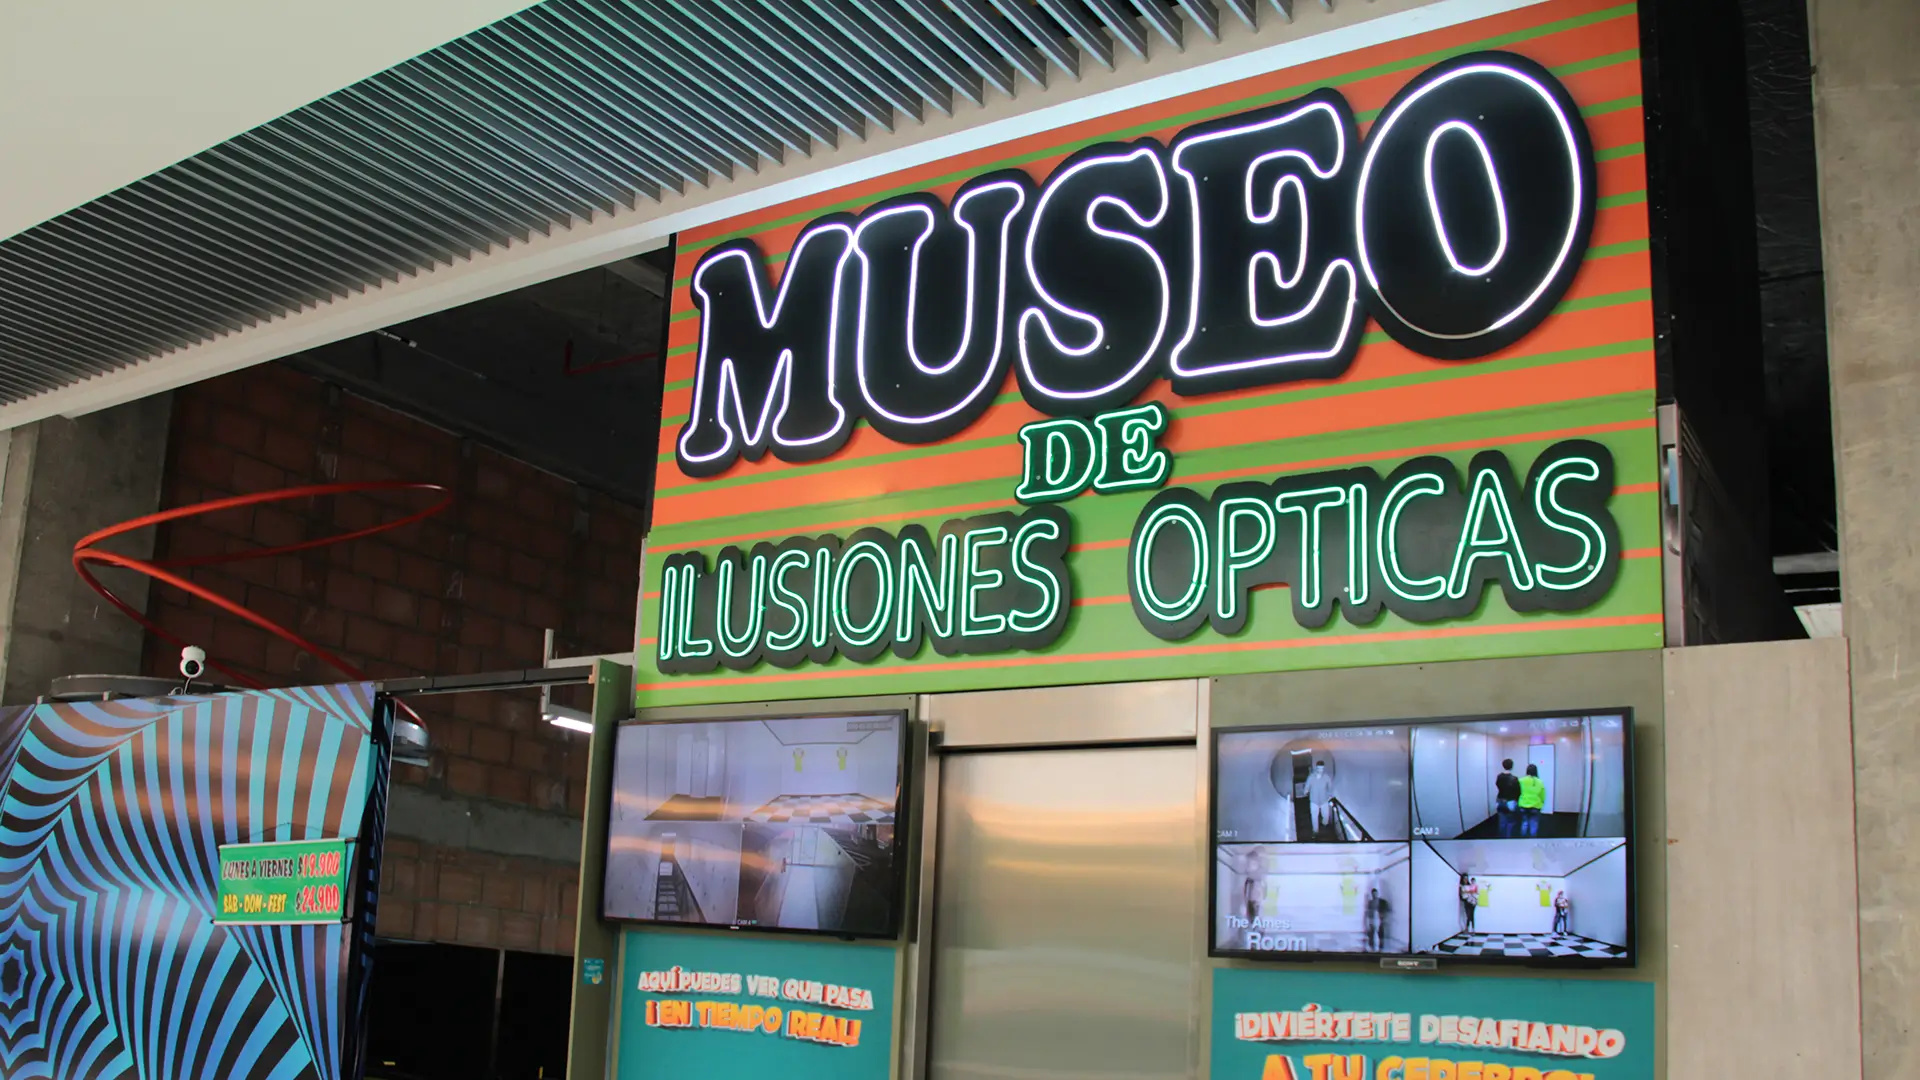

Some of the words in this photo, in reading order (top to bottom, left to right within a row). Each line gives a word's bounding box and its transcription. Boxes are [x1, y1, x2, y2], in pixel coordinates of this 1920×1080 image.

[679, 63, 1583, 462] MUSEO
[1015, 405, 1167, 500] DE
[659, 519, 1061, 660] ILUSIONES
[1135, 457, 1607, 622] OPTICAS
[222, 861, 250, 880] LUNES
[251, 859, 257, 878] A
[259, 858, 294, 879] VIERNES
[1225, 916, 1249, 929] The
[1252, 916, 1291, 929] Ames
[1247, 931, 1308, 951] Room
[638, 966, 683, 992] AQUÍ
[683, 972, 742, 994] PUEDES
[746, 974, 779, 998] VER
[782, 978, 822, 1004] QUE
[823, 984, 874, 1010] PASA
[695, 1001, 783, 1034] TIEMPO
[787, 1010, 862, 1047] REAL!
[1234, 1002, 1412, 1042] ¡DIVIÉRTETE
[1419, 1014, 1626, 1059] DESAFIANDO
[1262, 1053, 1298, 1080] A
[1303, 1053, 1367, 1080] TU
